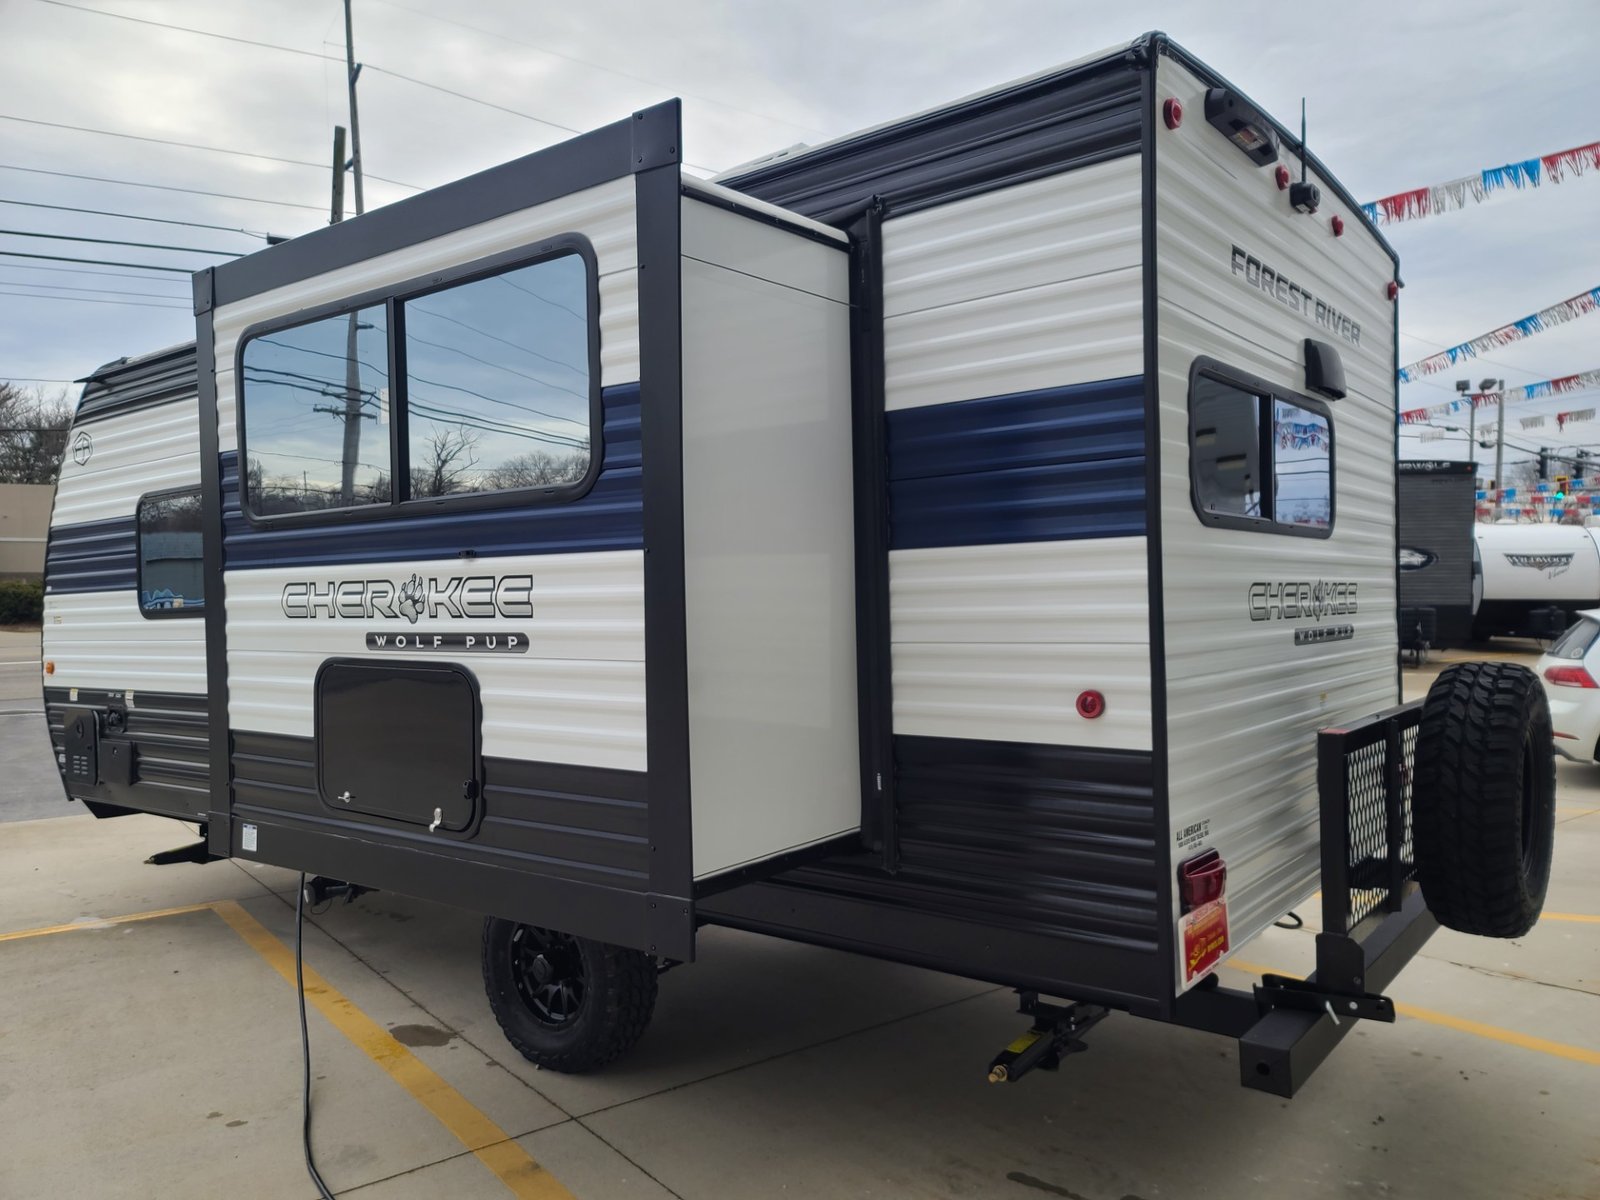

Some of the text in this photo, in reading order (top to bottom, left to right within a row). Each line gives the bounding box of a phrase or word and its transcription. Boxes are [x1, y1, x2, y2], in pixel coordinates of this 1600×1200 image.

[1231, 243, 1361, 347] FOREST RIVER
[375, 635, 519, 650] WOLF PUP
